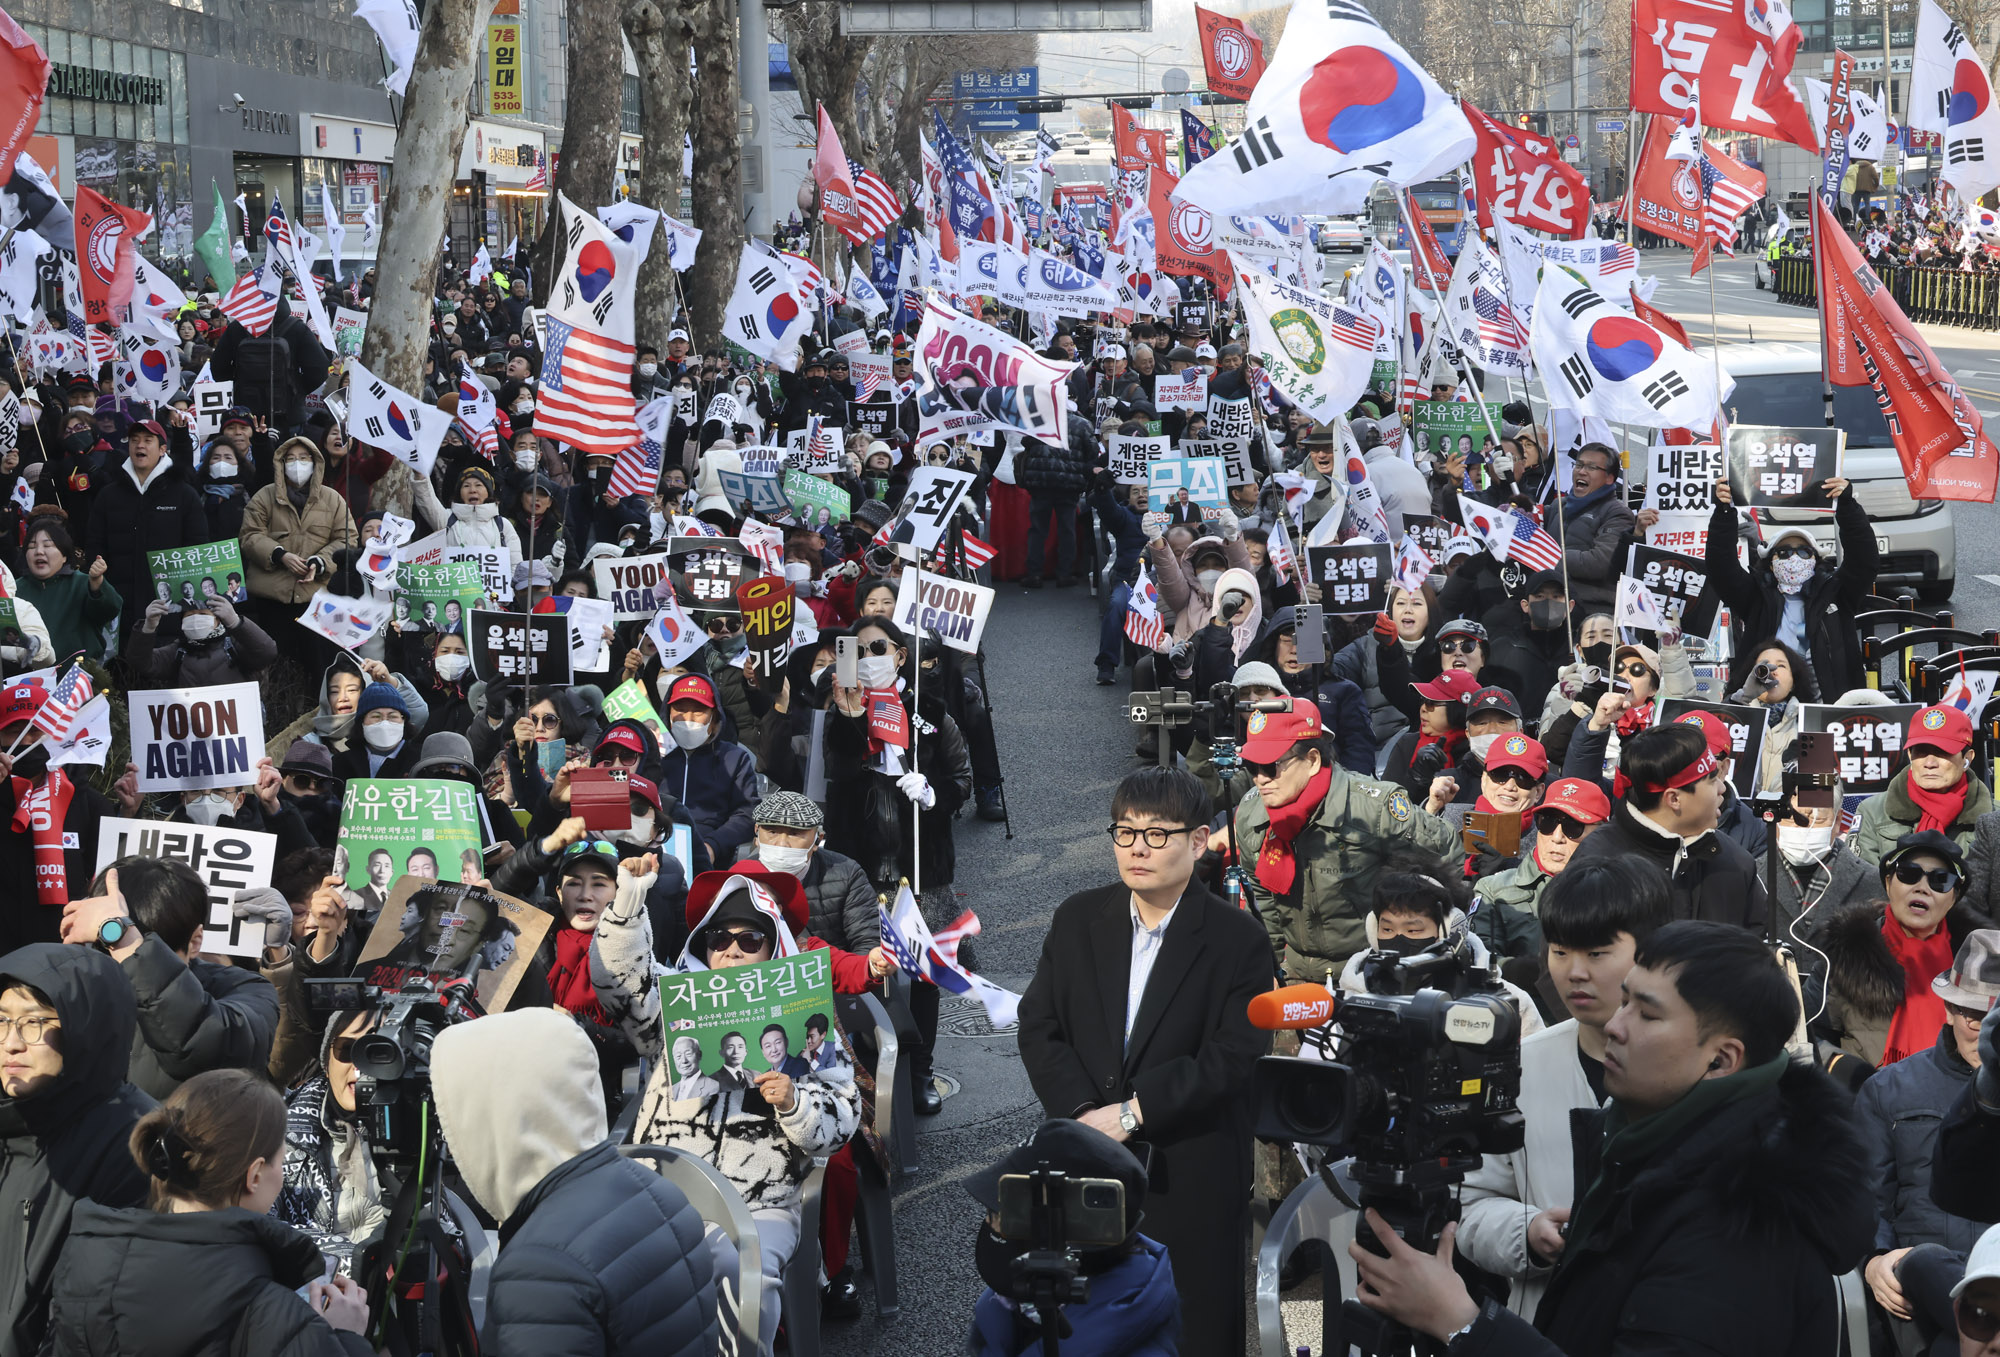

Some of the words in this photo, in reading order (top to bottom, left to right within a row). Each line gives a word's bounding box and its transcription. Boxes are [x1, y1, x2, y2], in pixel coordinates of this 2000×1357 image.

[494, 29, 515, 42] 7층
[51, 61, 123, 101] STARBUCKS
[126, 74, 166, 106] COFFEE
[494, 92, 517, 100] 533-
[1831, 61, 1849, 124] 우리가
[494, 102, 521, 110] 9100
[1639, 198, 1680, 226] 부정선거
[1044, 259, 1090, 288] 해사
[1861, 323, 1914, 395] ANTI-CORRUPTION
[856, 409, 888, 422] 윤석열
[944, 416, 965, 431] RESET
[1213, 401, 1252, 422] 내란은
[1210, 419, 1254, 440] 없었다
[740, 450, 778, 461] YOON
[1118, 443, 1163, 461] 계엄은
[1748, 442, 1817, 469] 윤석열
[743, 460, 781, 474] GAIN
[788, 472, 850, 507] 자유한길단
[1149, 460, 1226, 505] 무죄
[1759, 471, 1804, 496] 무죄
[1656, 481, 1713, 512] 없었
[1201, 507, 1223, 520] Yoo
[1654, 531, 1696, 547] 지귀연
[151, 541, 237, 570] 자유한길단
[684, 552, 743, 576] 윤석열
[396, 564, 480, 588] 자유한길단
[1324, 556, 1378, 582] 윤석열
[1643, 561, 1707, 598] 윤석열
[693, 578, 731, 600] 무죄
[918, 579, 977, 617] YOON
[1334, 583, 1370, 605] 무죄
[905, 602, 975, 643] AGAIN
[487, 624, 549, 652] 윤석열
[497, 655, 539, 677] 무죄
[147, 699, 239, 740] YOON
[872, 720, 901, 734] AGAIN
[1826, 721, 1903, 752] 윤석열
[146, 736, 249, 779] AGAIN
[1839, 756, 1889, 782] 무죄
[341, 783, 477, 823] 자유한길단
[668, 955, 828, 1011] 자유한길단
[1283, 1000, 1331, 1021] 연합뉴스TV
[1452, 1017, 1491, 1030] 연합뉴스TV
